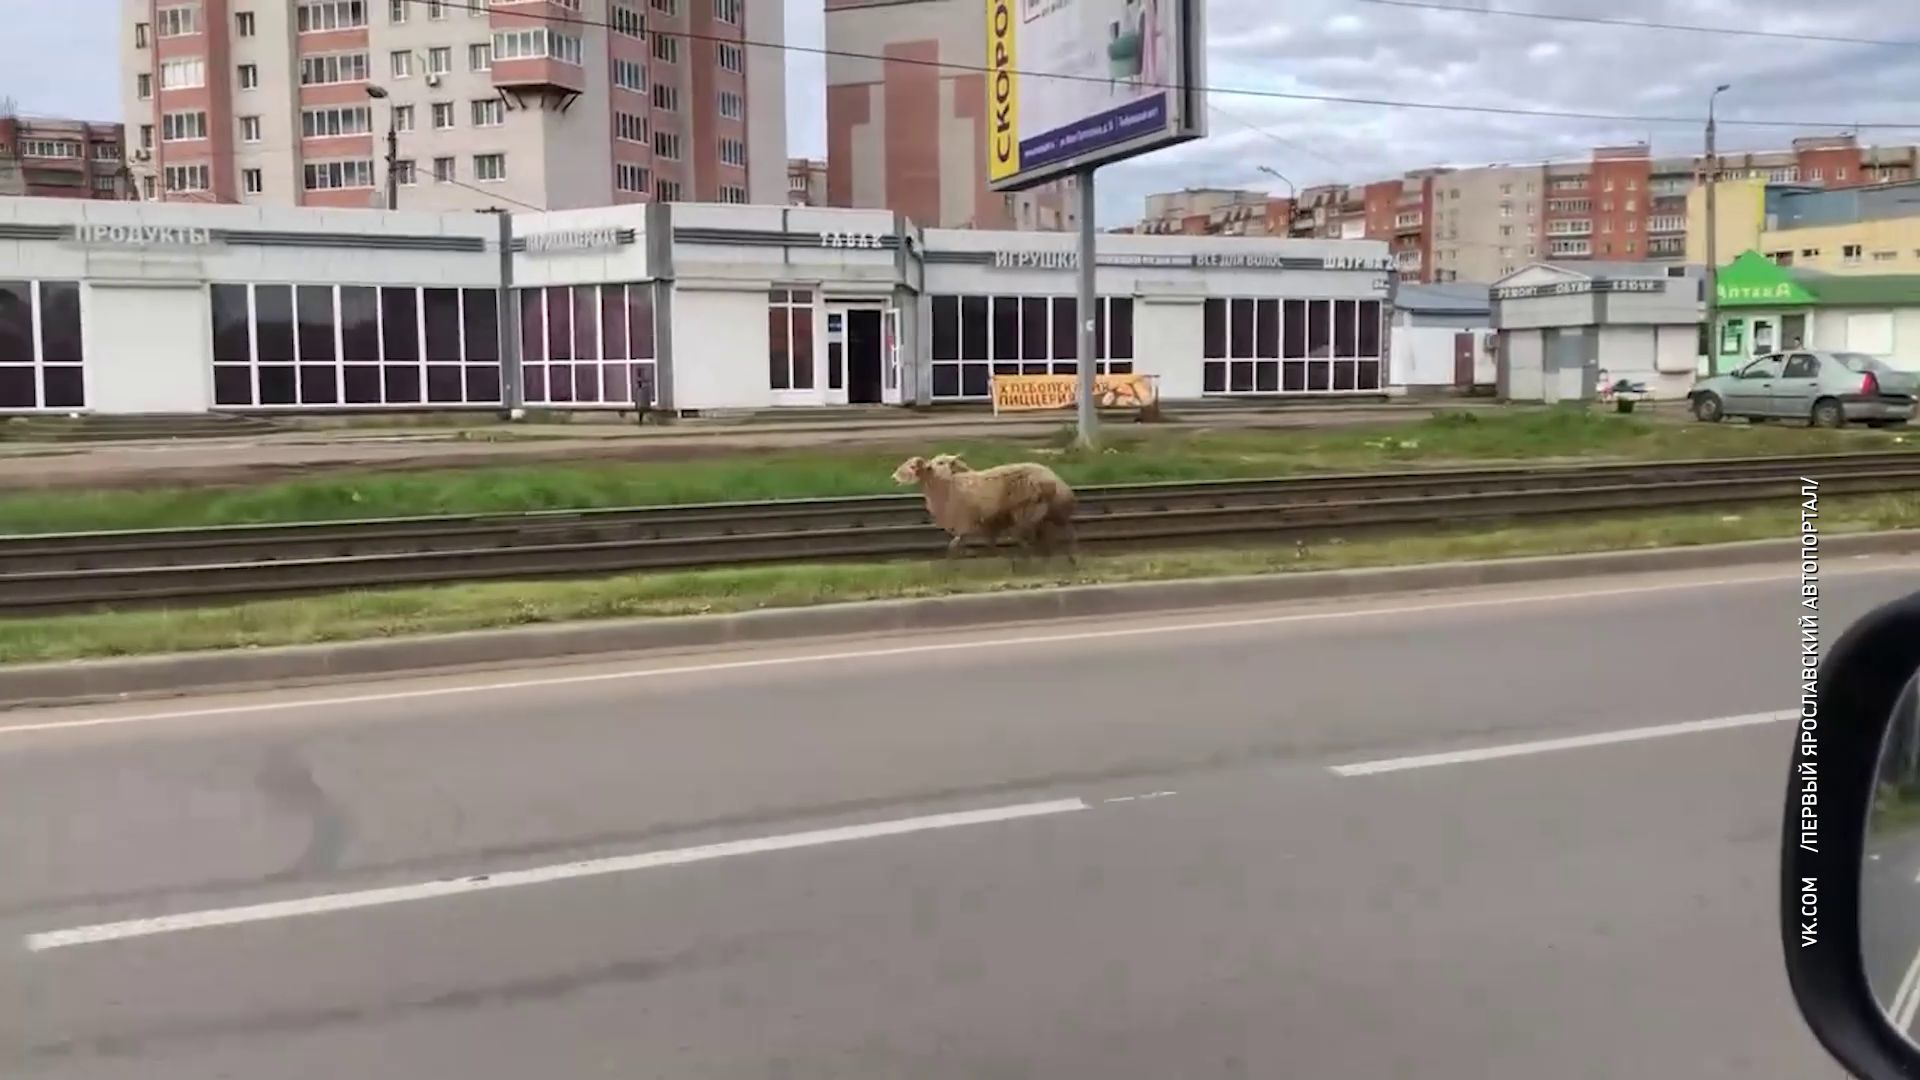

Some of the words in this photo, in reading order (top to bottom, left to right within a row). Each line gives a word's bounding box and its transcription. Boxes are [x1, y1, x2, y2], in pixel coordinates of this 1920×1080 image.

[994, 0, 1010, 162] СКОРО
[75, 224, 210, 245] ПРОДУКТЫ
[820, 232, 882, 248] ТАБАК
[995, 250, 1080, 268] ИГРУШКИ
[1323, 254, 1383, 269] ШАУРМА
[1498, 286, 1538, 299] РЕМОНТ
[1556, 281, 1592, 294] ОБУВИ
